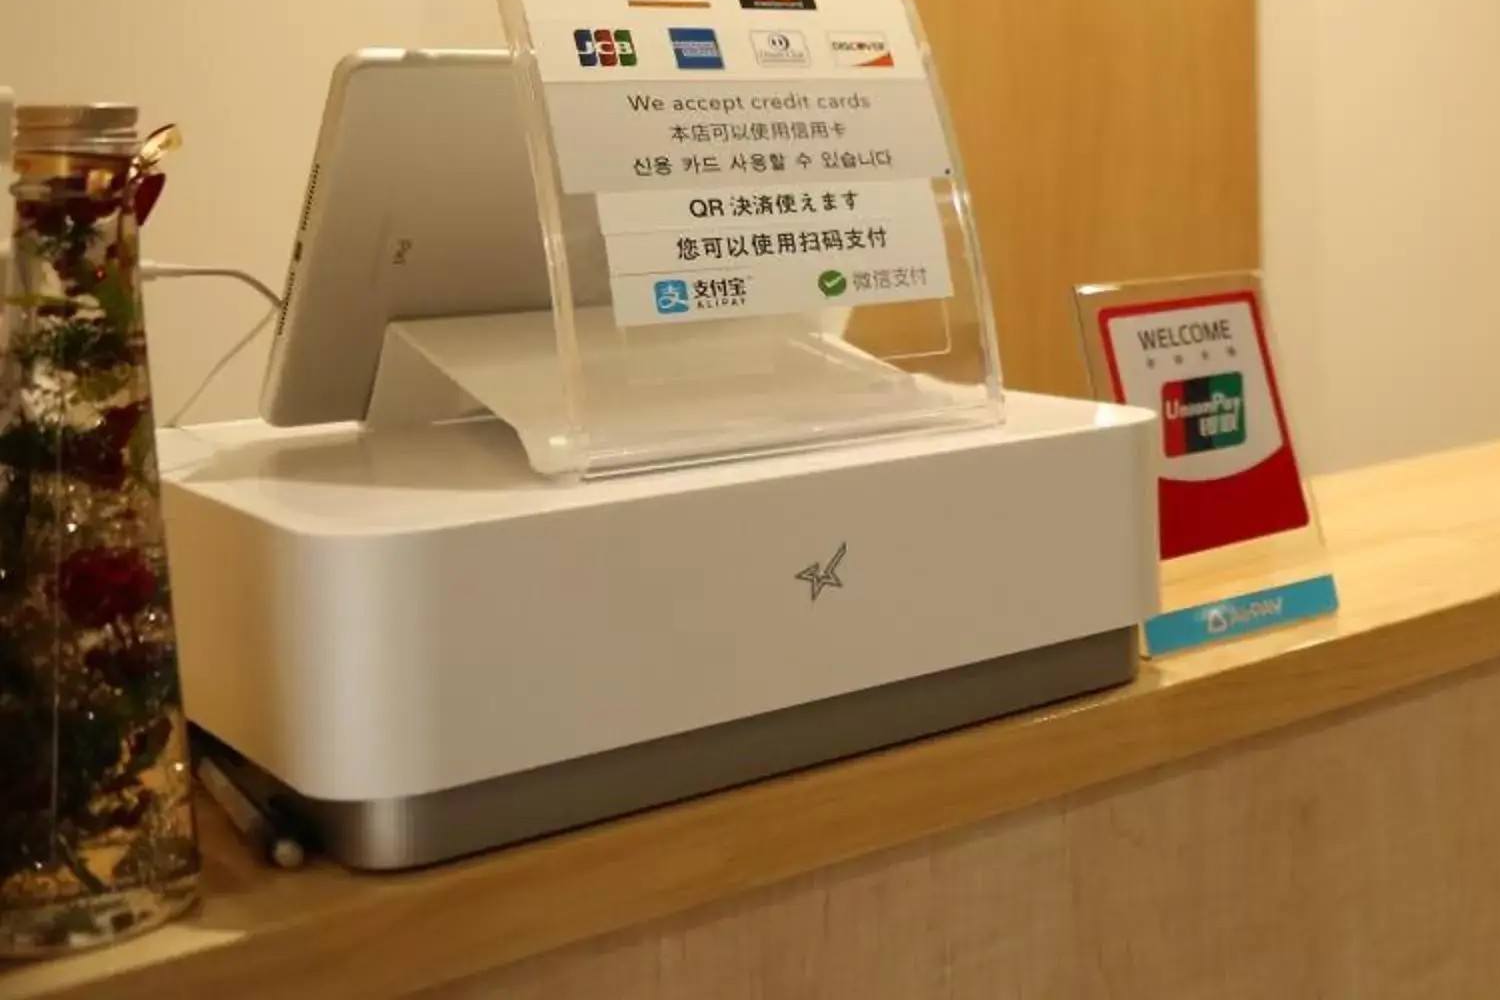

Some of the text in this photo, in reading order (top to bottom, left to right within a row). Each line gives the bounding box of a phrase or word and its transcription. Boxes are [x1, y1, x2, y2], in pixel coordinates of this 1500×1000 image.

[627, 91, 871, 114] We accept credit cards
[670, 121, 846, 143] 本店可以使用信用卡
[633, 148, 893, 176] 신용 카드 사용할 수 있습니다
[689, 189, 860, 219] QR 決済使えます
[676, 226, 888, 260] 您可以使用扫码支付
[694, 278, 747, 299] 支付宝
[852, 266, 928, 291] 微信支付
[1137, 319, 1233, 351] WELCOME
